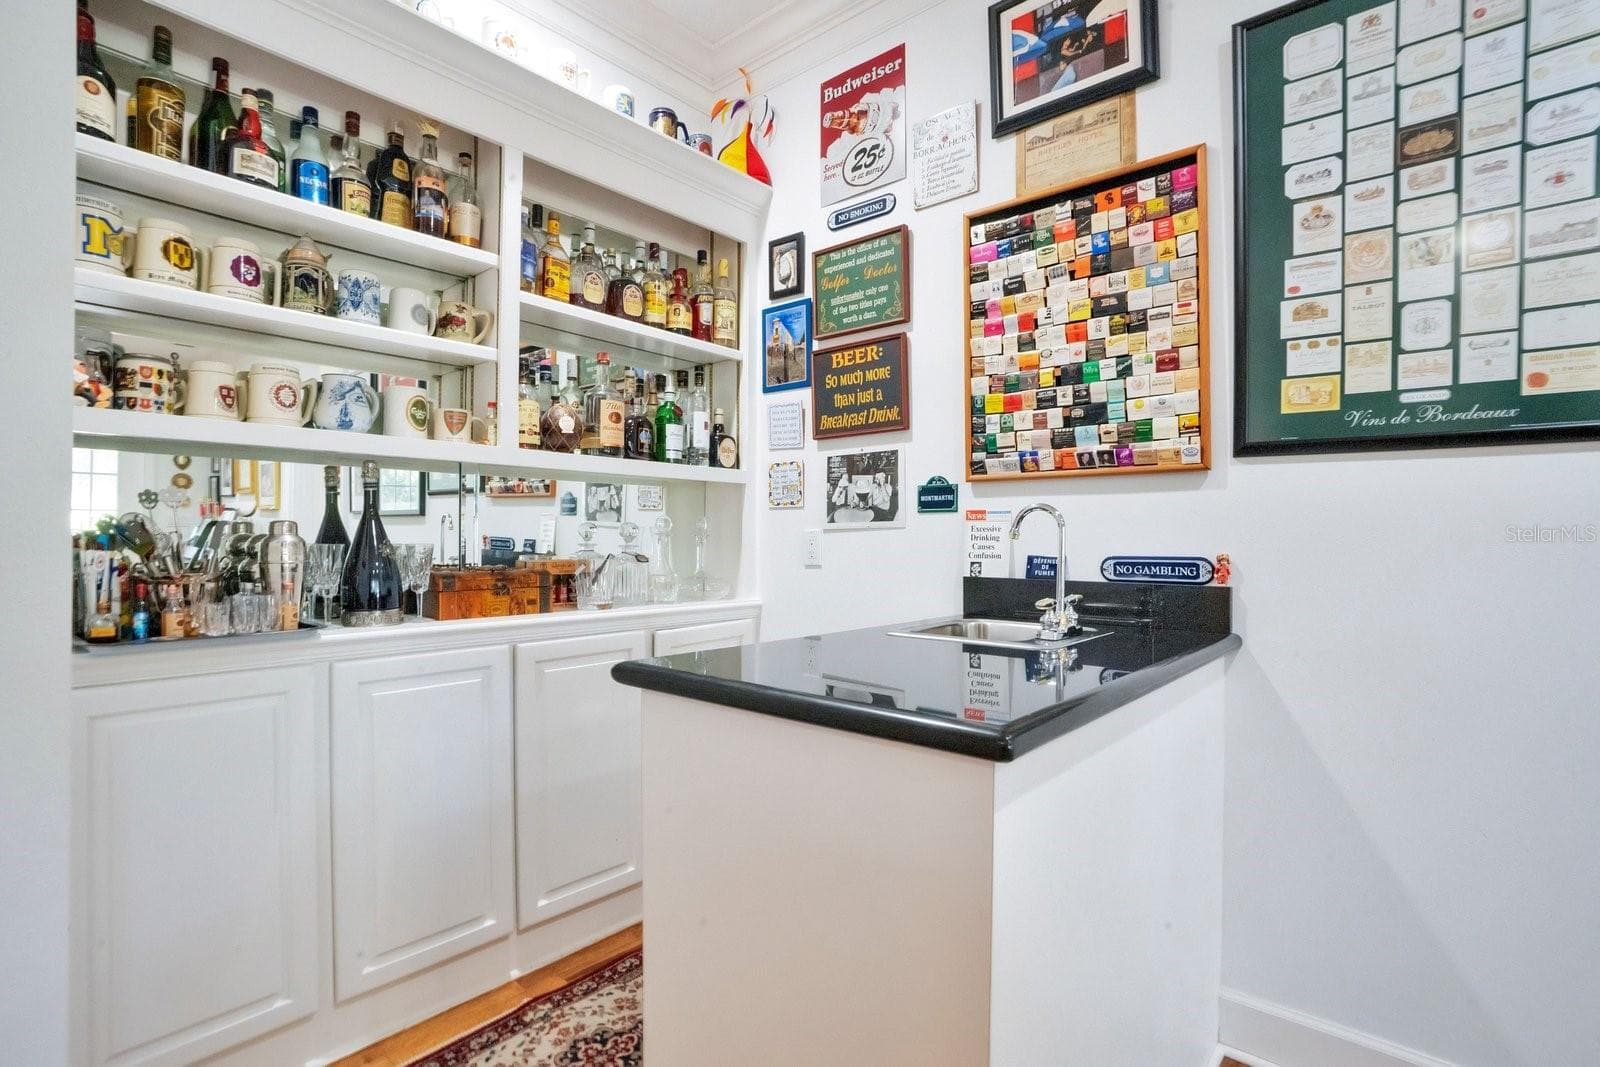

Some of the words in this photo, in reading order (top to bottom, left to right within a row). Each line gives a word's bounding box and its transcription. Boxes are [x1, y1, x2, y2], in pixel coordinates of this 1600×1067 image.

[823, 58, 902, 103] Budweiser
[838, 213, 849, 223] NO
[850, 201, 884, 218] SMOKING
[847, 247, 856, 256] the
[824, 260, 855, 275] experienced
[856, 255, 867, 265] and
[868, 248, 895, 262] dedicated
[863, 262, 897, 280] Doctor
[830, 290, 864, 306] unfortunately
[865, 285, 878, 296] only
[839, 304, 848, 313] the
[849, 302, 859, 311] two
[831, 345, 883, 369] BEER:
[876, 388, 883, 401] a
[1344, 409, 1386, 428] Vins
[1390, 409, 1411, 425] de
[1416, 403, 1521, 424] Bordeaux
[970, 534, 1001, 542] Drinking
[968, 551, 1002, 559] Confusion
[1115, 564, 1132, 574] NO
[1134, 565, 1197, 576] GAMBLING
